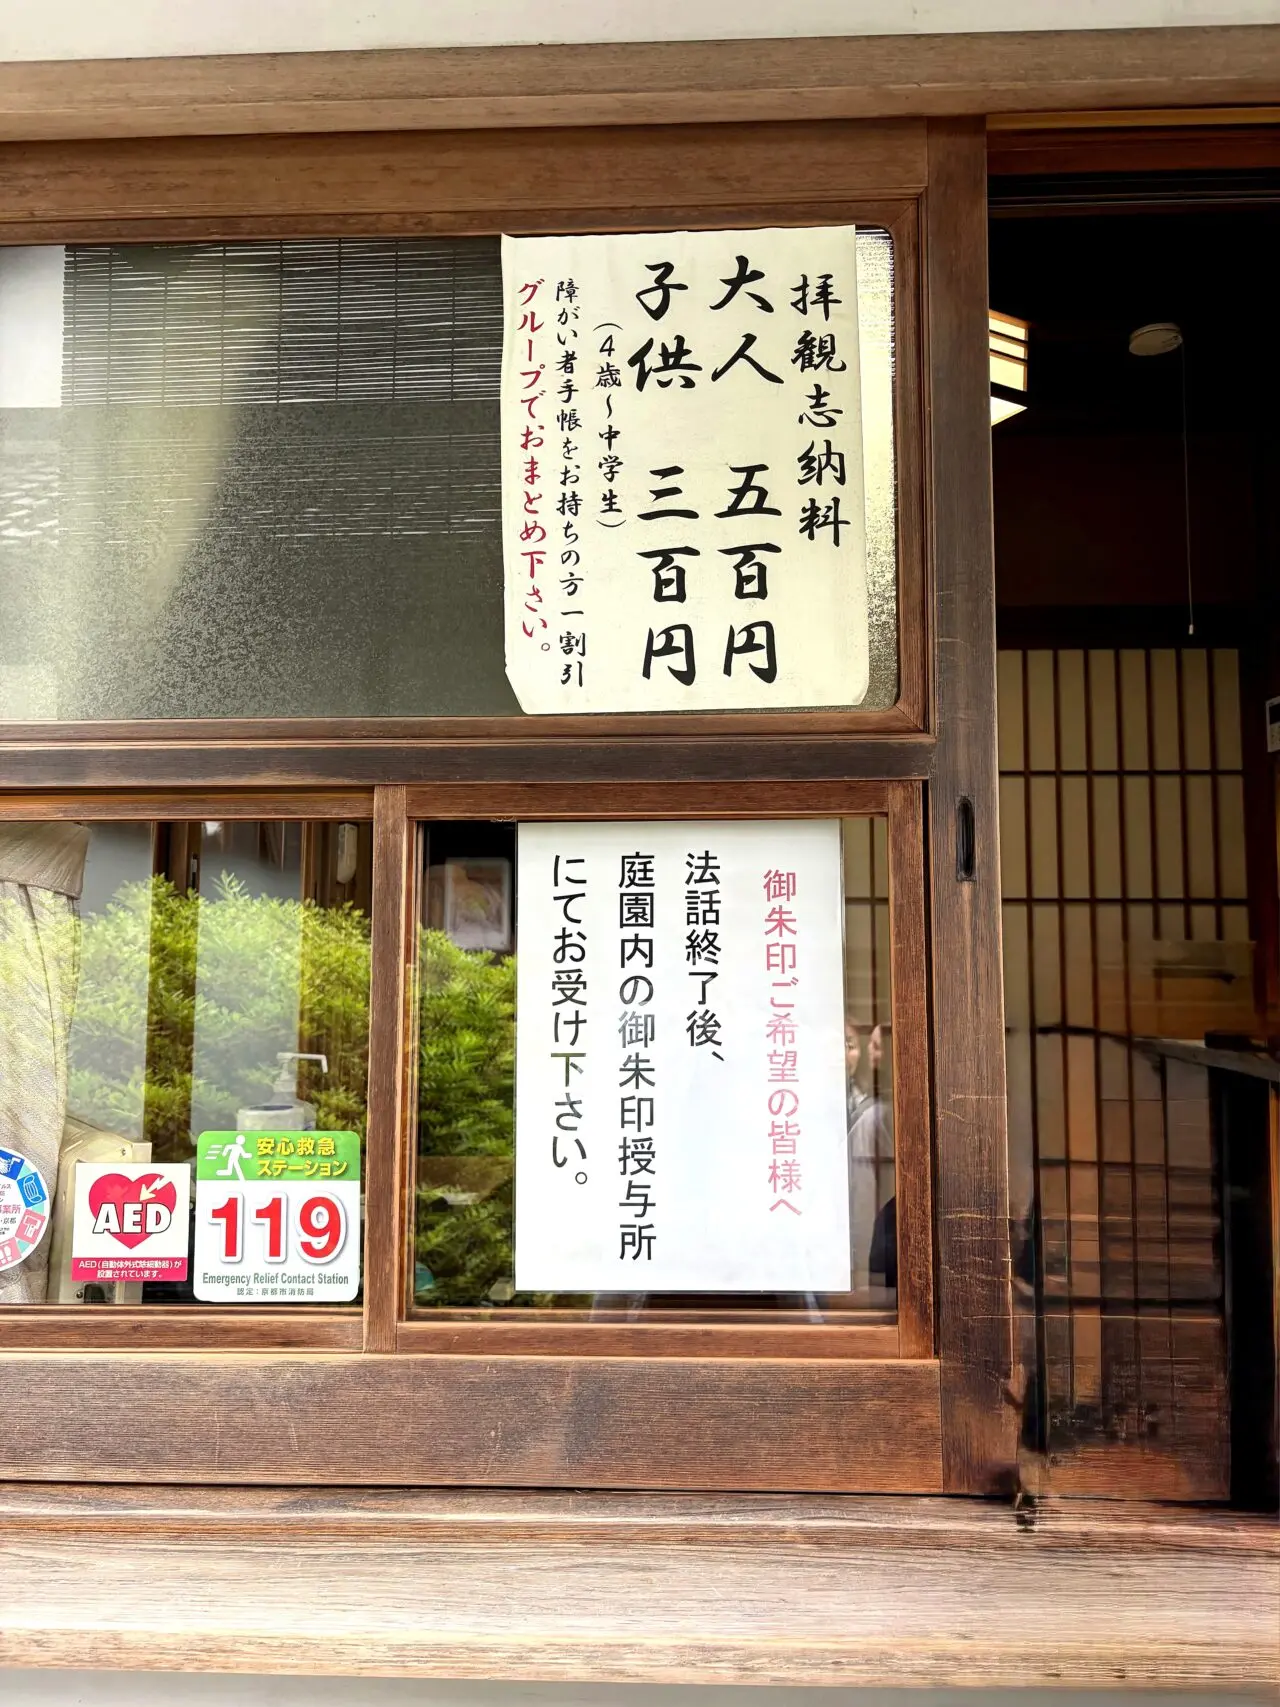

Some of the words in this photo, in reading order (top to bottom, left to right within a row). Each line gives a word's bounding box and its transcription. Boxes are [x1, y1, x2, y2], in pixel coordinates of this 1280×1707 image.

[627, 261, 703, 392] 子供
[709, 255, 784, 385] 大人
[790, 273, 852, 548] 拝観志納料
[517, 278, 551, 652] グループでおまとめ下さい。
[556, 279, 586, 688] 障がい者手帳をお持ちの方一割引
[636, 465, 701, 687] 三百円
[714, 463, 783, 684] 五百円
[551, 854, 588, 1185] にてお受け下さい。
[618, 851, 657, 1261] 庭園内の御朱印授与所
[685, 850, 724, 1061] 法話終了後、
[763, 869, 802, 1217] 御朱印ご希望の皆様へ
[92, 1202, 173, 1235] AED
[210, 1195, 344, 1259] 119
[257, 1137, 335, 1156] 安心救急
[257, 1160, 348, 1177] ステーション
[202, 1272, 250, 1286] Emergency
[253, 1272, 279, 1285] Relief
[281, 1272, 316, 1285] Contact
[317, 1273, 349, 1285] Station
